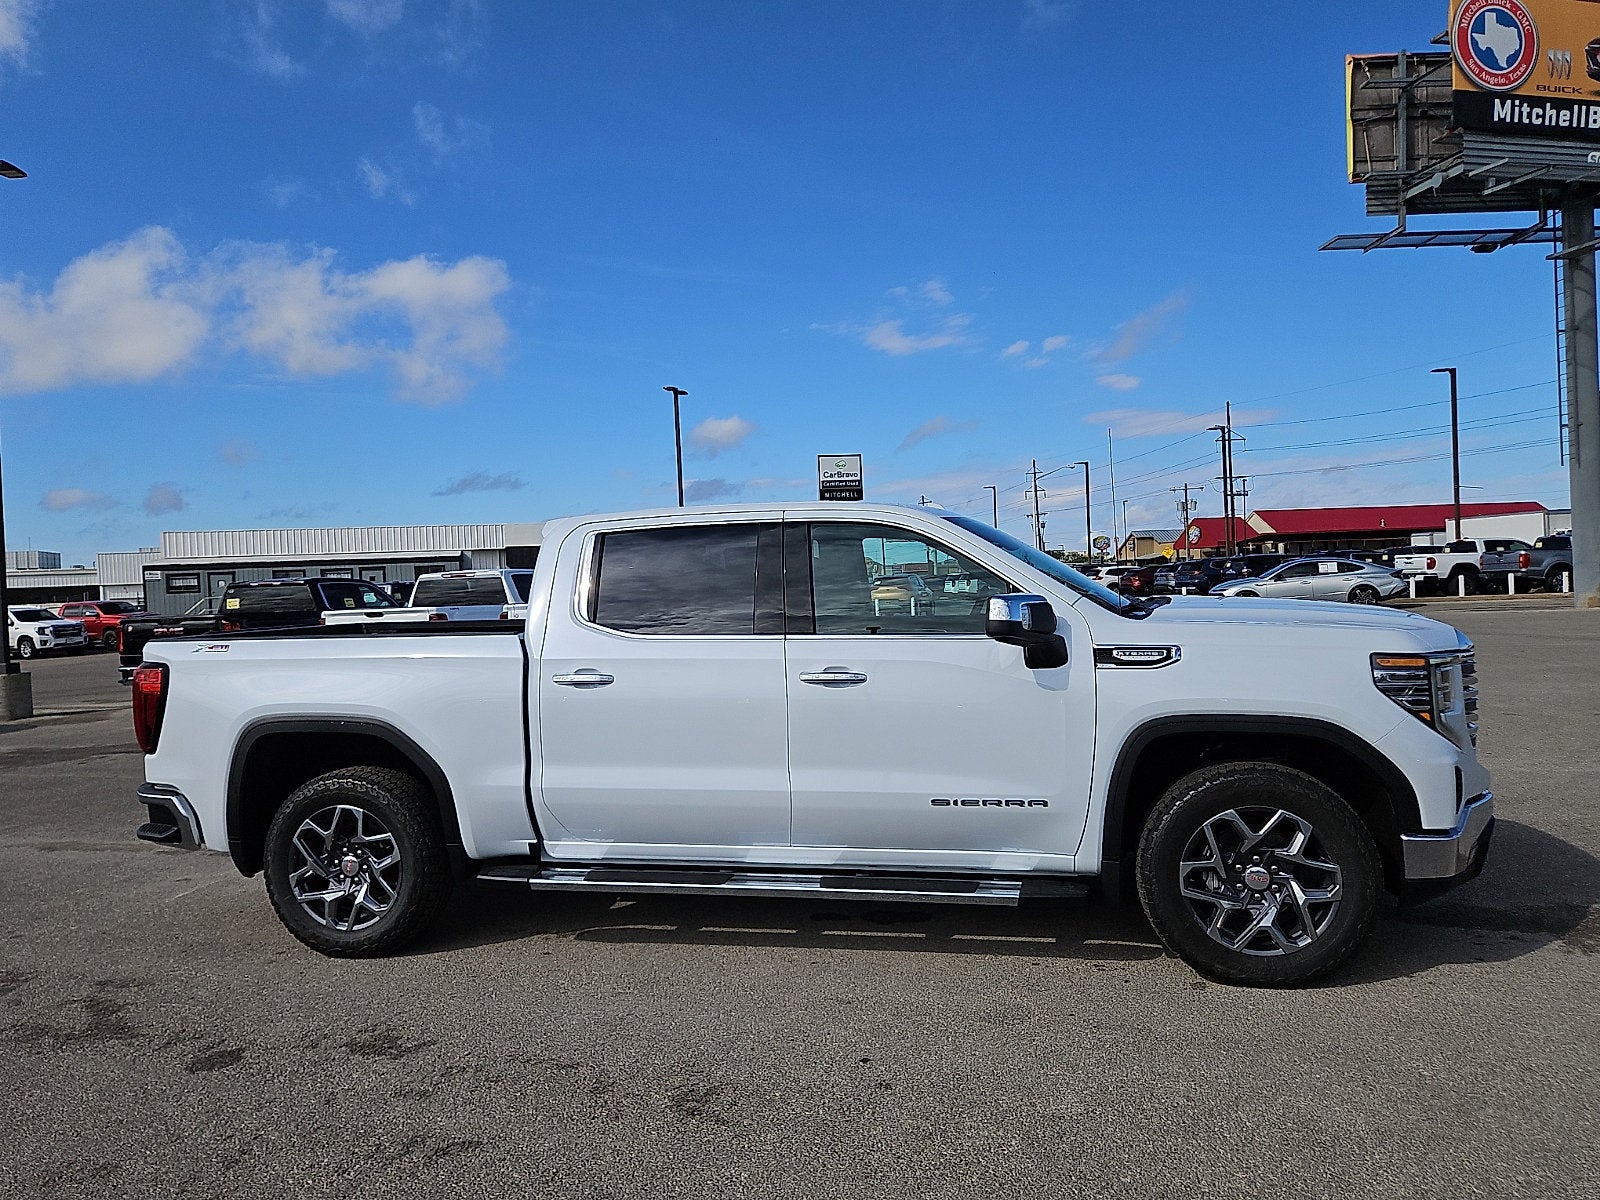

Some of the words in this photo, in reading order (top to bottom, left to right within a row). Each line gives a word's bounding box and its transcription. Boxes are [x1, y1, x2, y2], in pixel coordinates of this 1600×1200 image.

[1516, 10, 1532, 34] GMC
[1466, 58, 1479, 75] San
[1480, 71, 1508, 85] Angelo,
[1508, 63, 1527, 81] Texas
[1536, 84, 1583, 95] BUICK
[1493, 98, 1600, 129] MitchellB
[823, 470, 859, 479] CarBravo
[930, 798, 1049, 808] SIERRA
